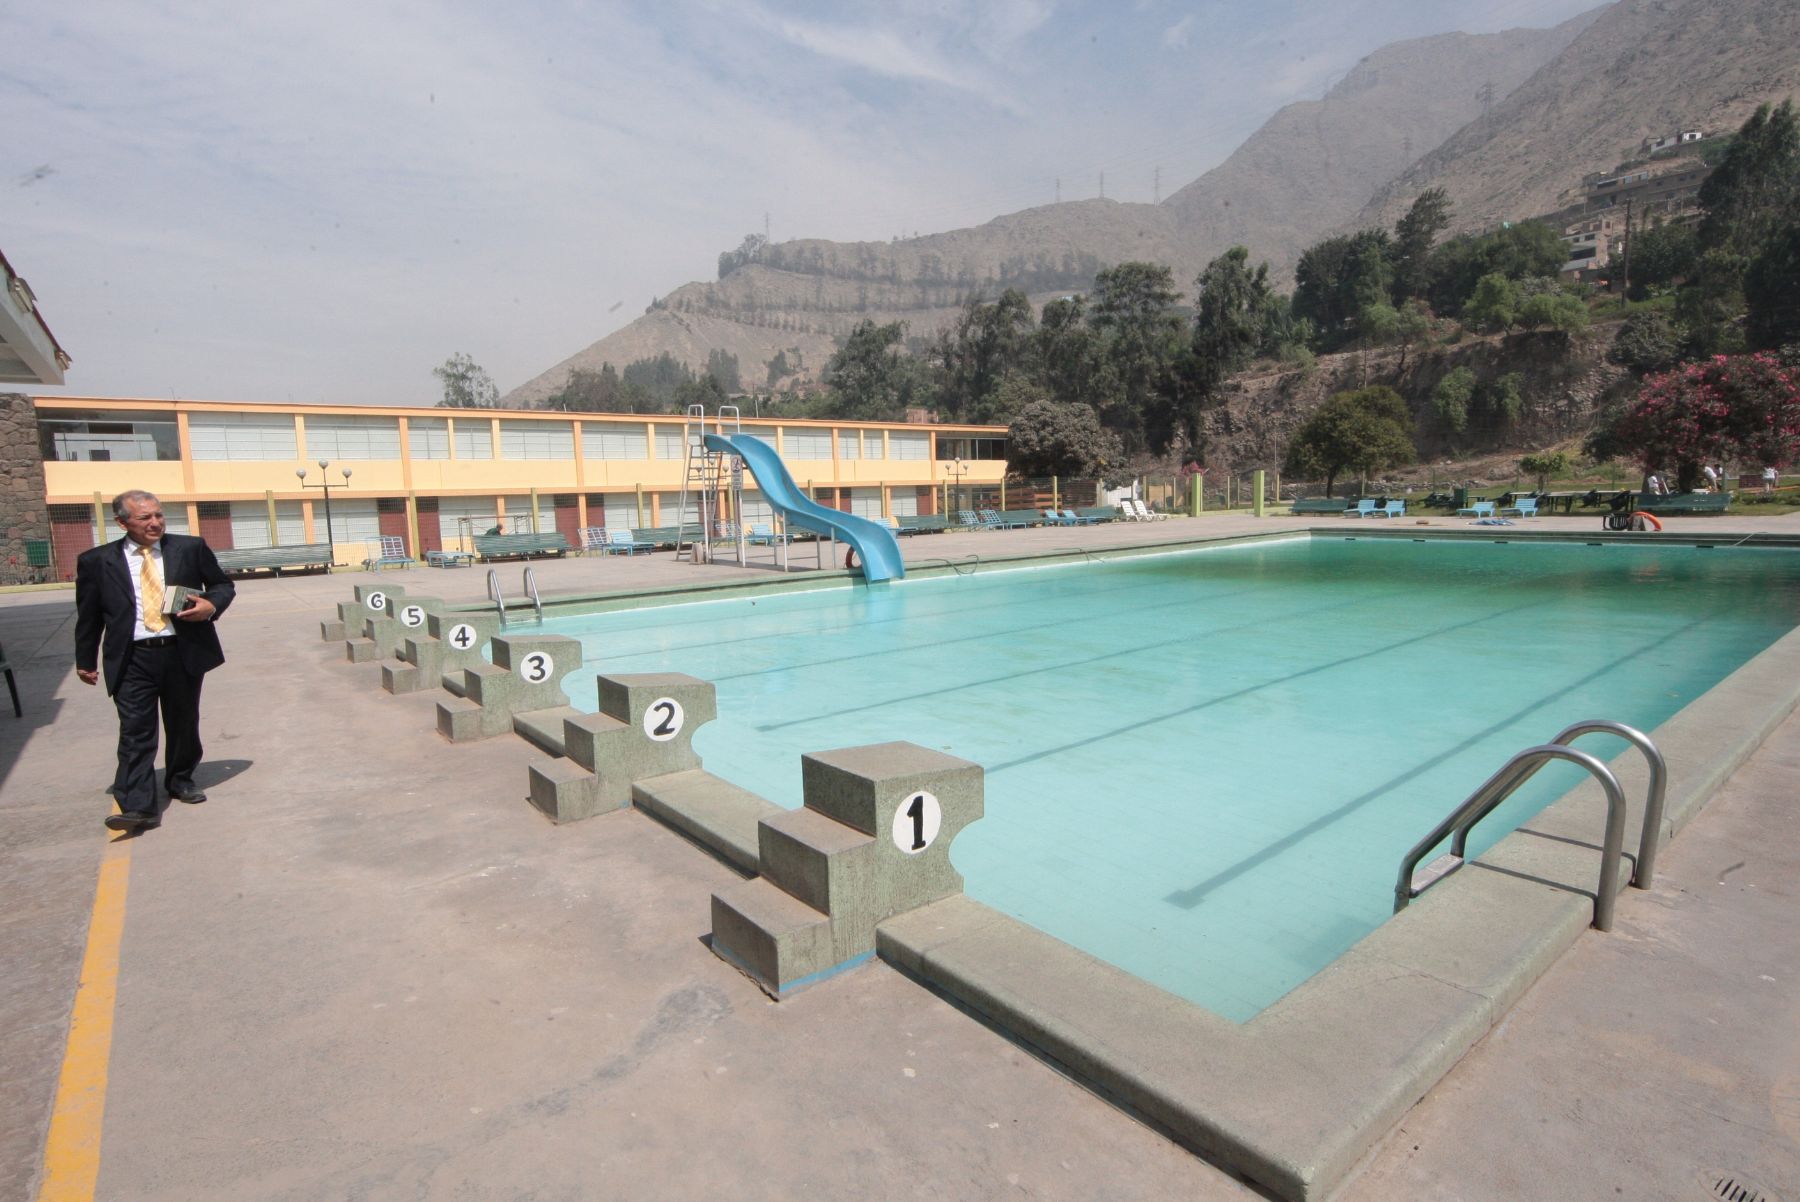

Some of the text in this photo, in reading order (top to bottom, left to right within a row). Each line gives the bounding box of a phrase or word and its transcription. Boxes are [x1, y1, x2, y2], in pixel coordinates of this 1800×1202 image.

[370, 593, 383, 609] 6
[407, 608, 421, 626] 5
[454, 626, 470, 648] 4
[528, 655, 546, 681] 3
[653, 702, 676, 736] 2
[907, 796, 927, 851] 1
